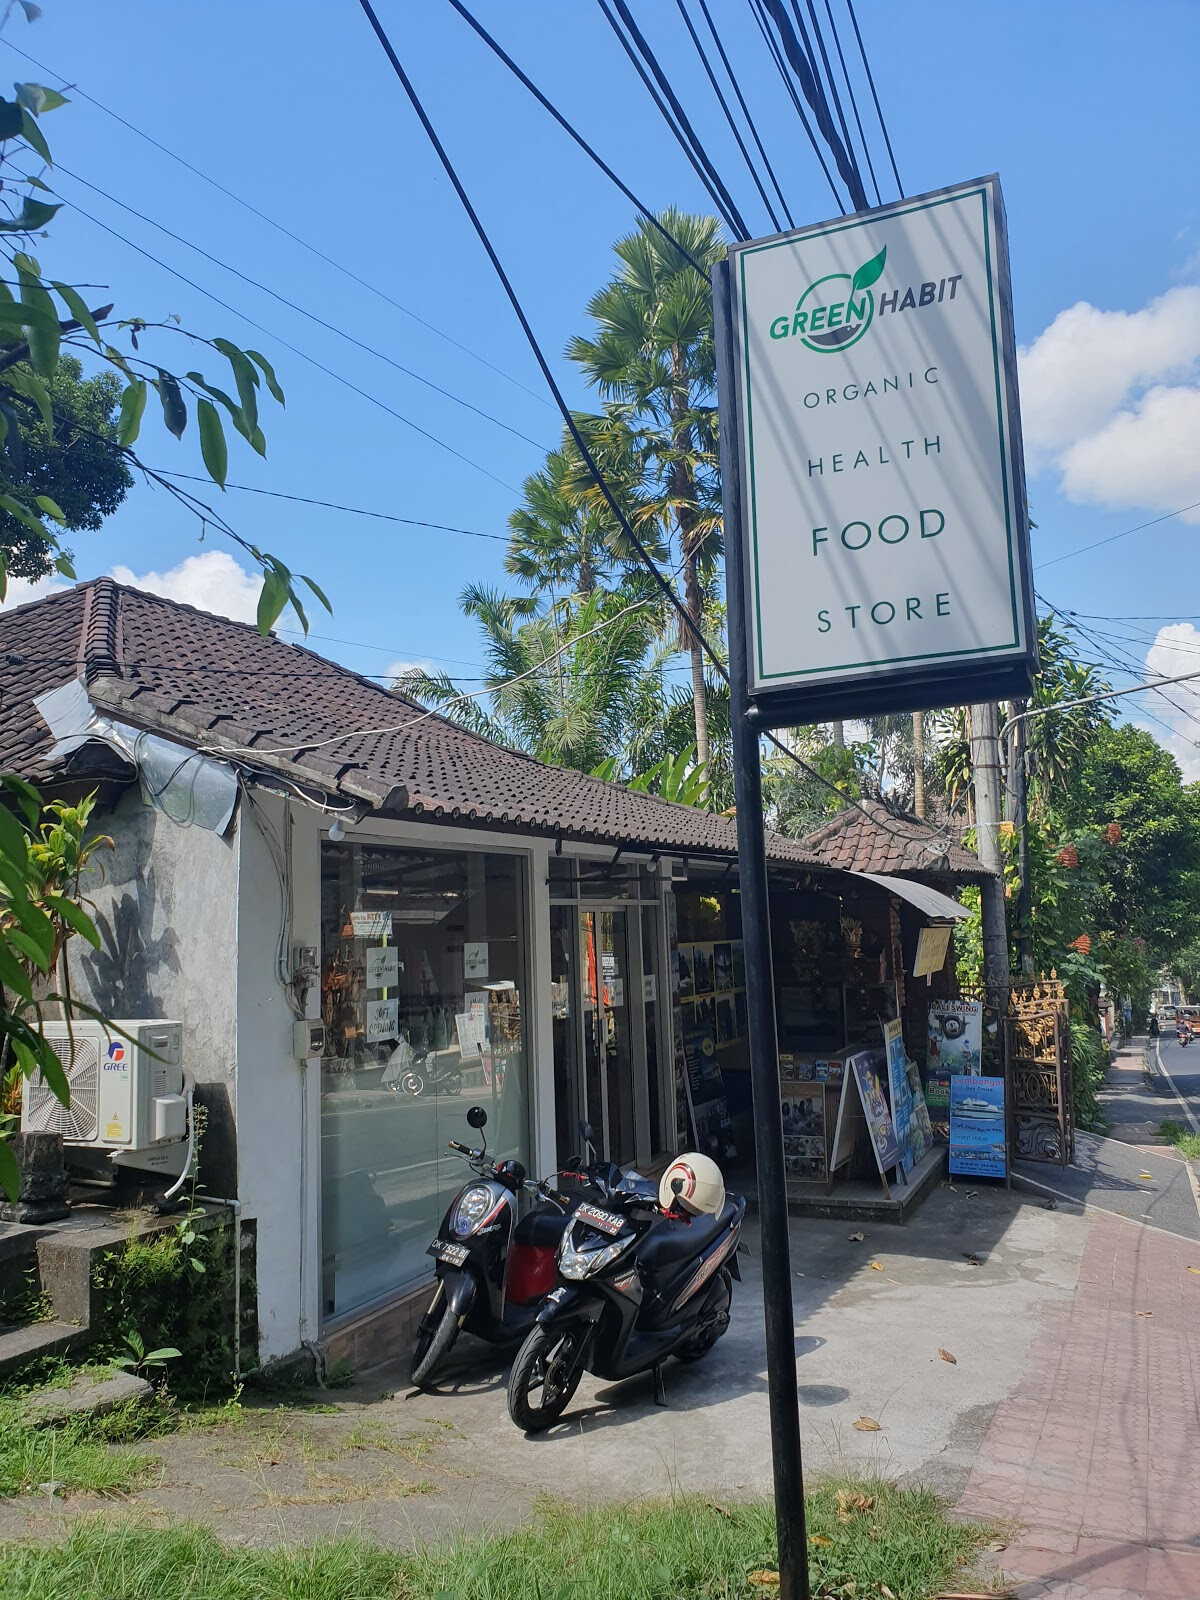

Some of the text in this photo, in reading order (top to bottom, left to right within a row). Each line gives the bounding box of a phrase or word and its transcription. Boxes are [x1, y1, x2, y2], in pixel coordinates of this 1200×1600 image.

[770, 275, 963, 340] GREEN HABIT
[803, 367, 939, 409] ORGANIC
[808, 435, 941, 477] HEALTH
[812, 509, 946, 557] FOOD
[817, 592, 951, 633] STORE
[374, 1006, 390, 1021] SOFT
[931, 1003, 978, 1013] BALI SWING
[368, 1020, 396, 1035] OPENING
[103, 1062, 128, 1072] GREE
[929, 1087, 950, 1095] Book
[578, 1202, 625, 1228] DK 2090 KAB
[431, 1239, 443, 1249] DK
[442, 1243, 460, 1256] 7522
